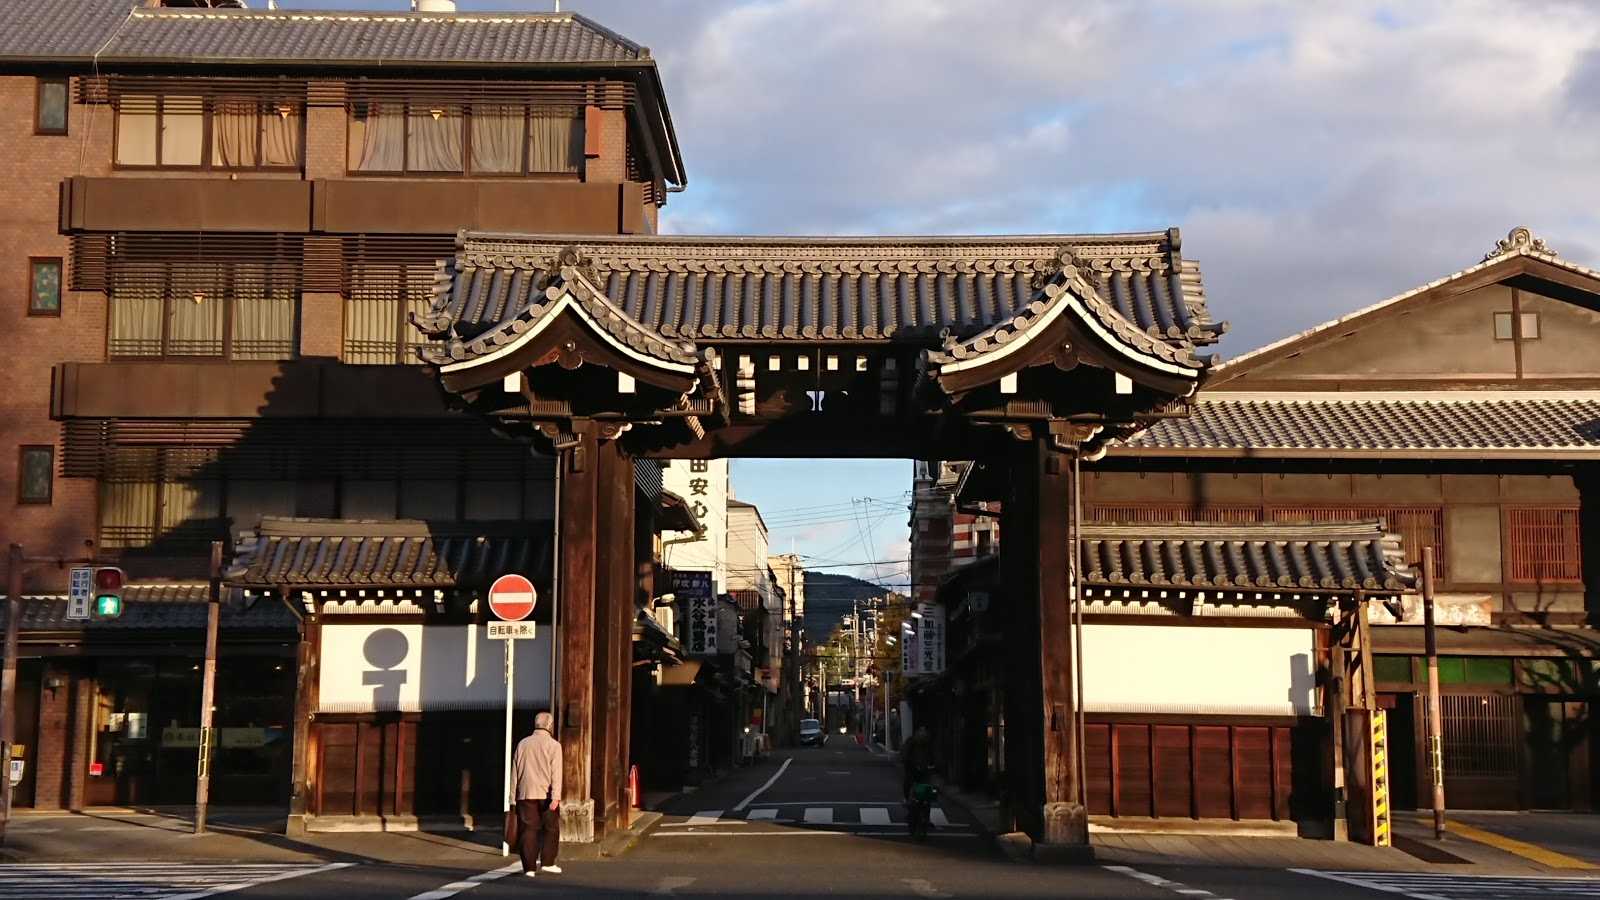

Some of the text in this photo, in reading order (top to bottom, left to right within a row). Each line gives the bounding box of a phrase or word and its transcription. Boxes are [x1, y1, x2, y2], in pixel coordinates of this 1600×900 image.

[490, 625, 533, 635] 自転車を除く
